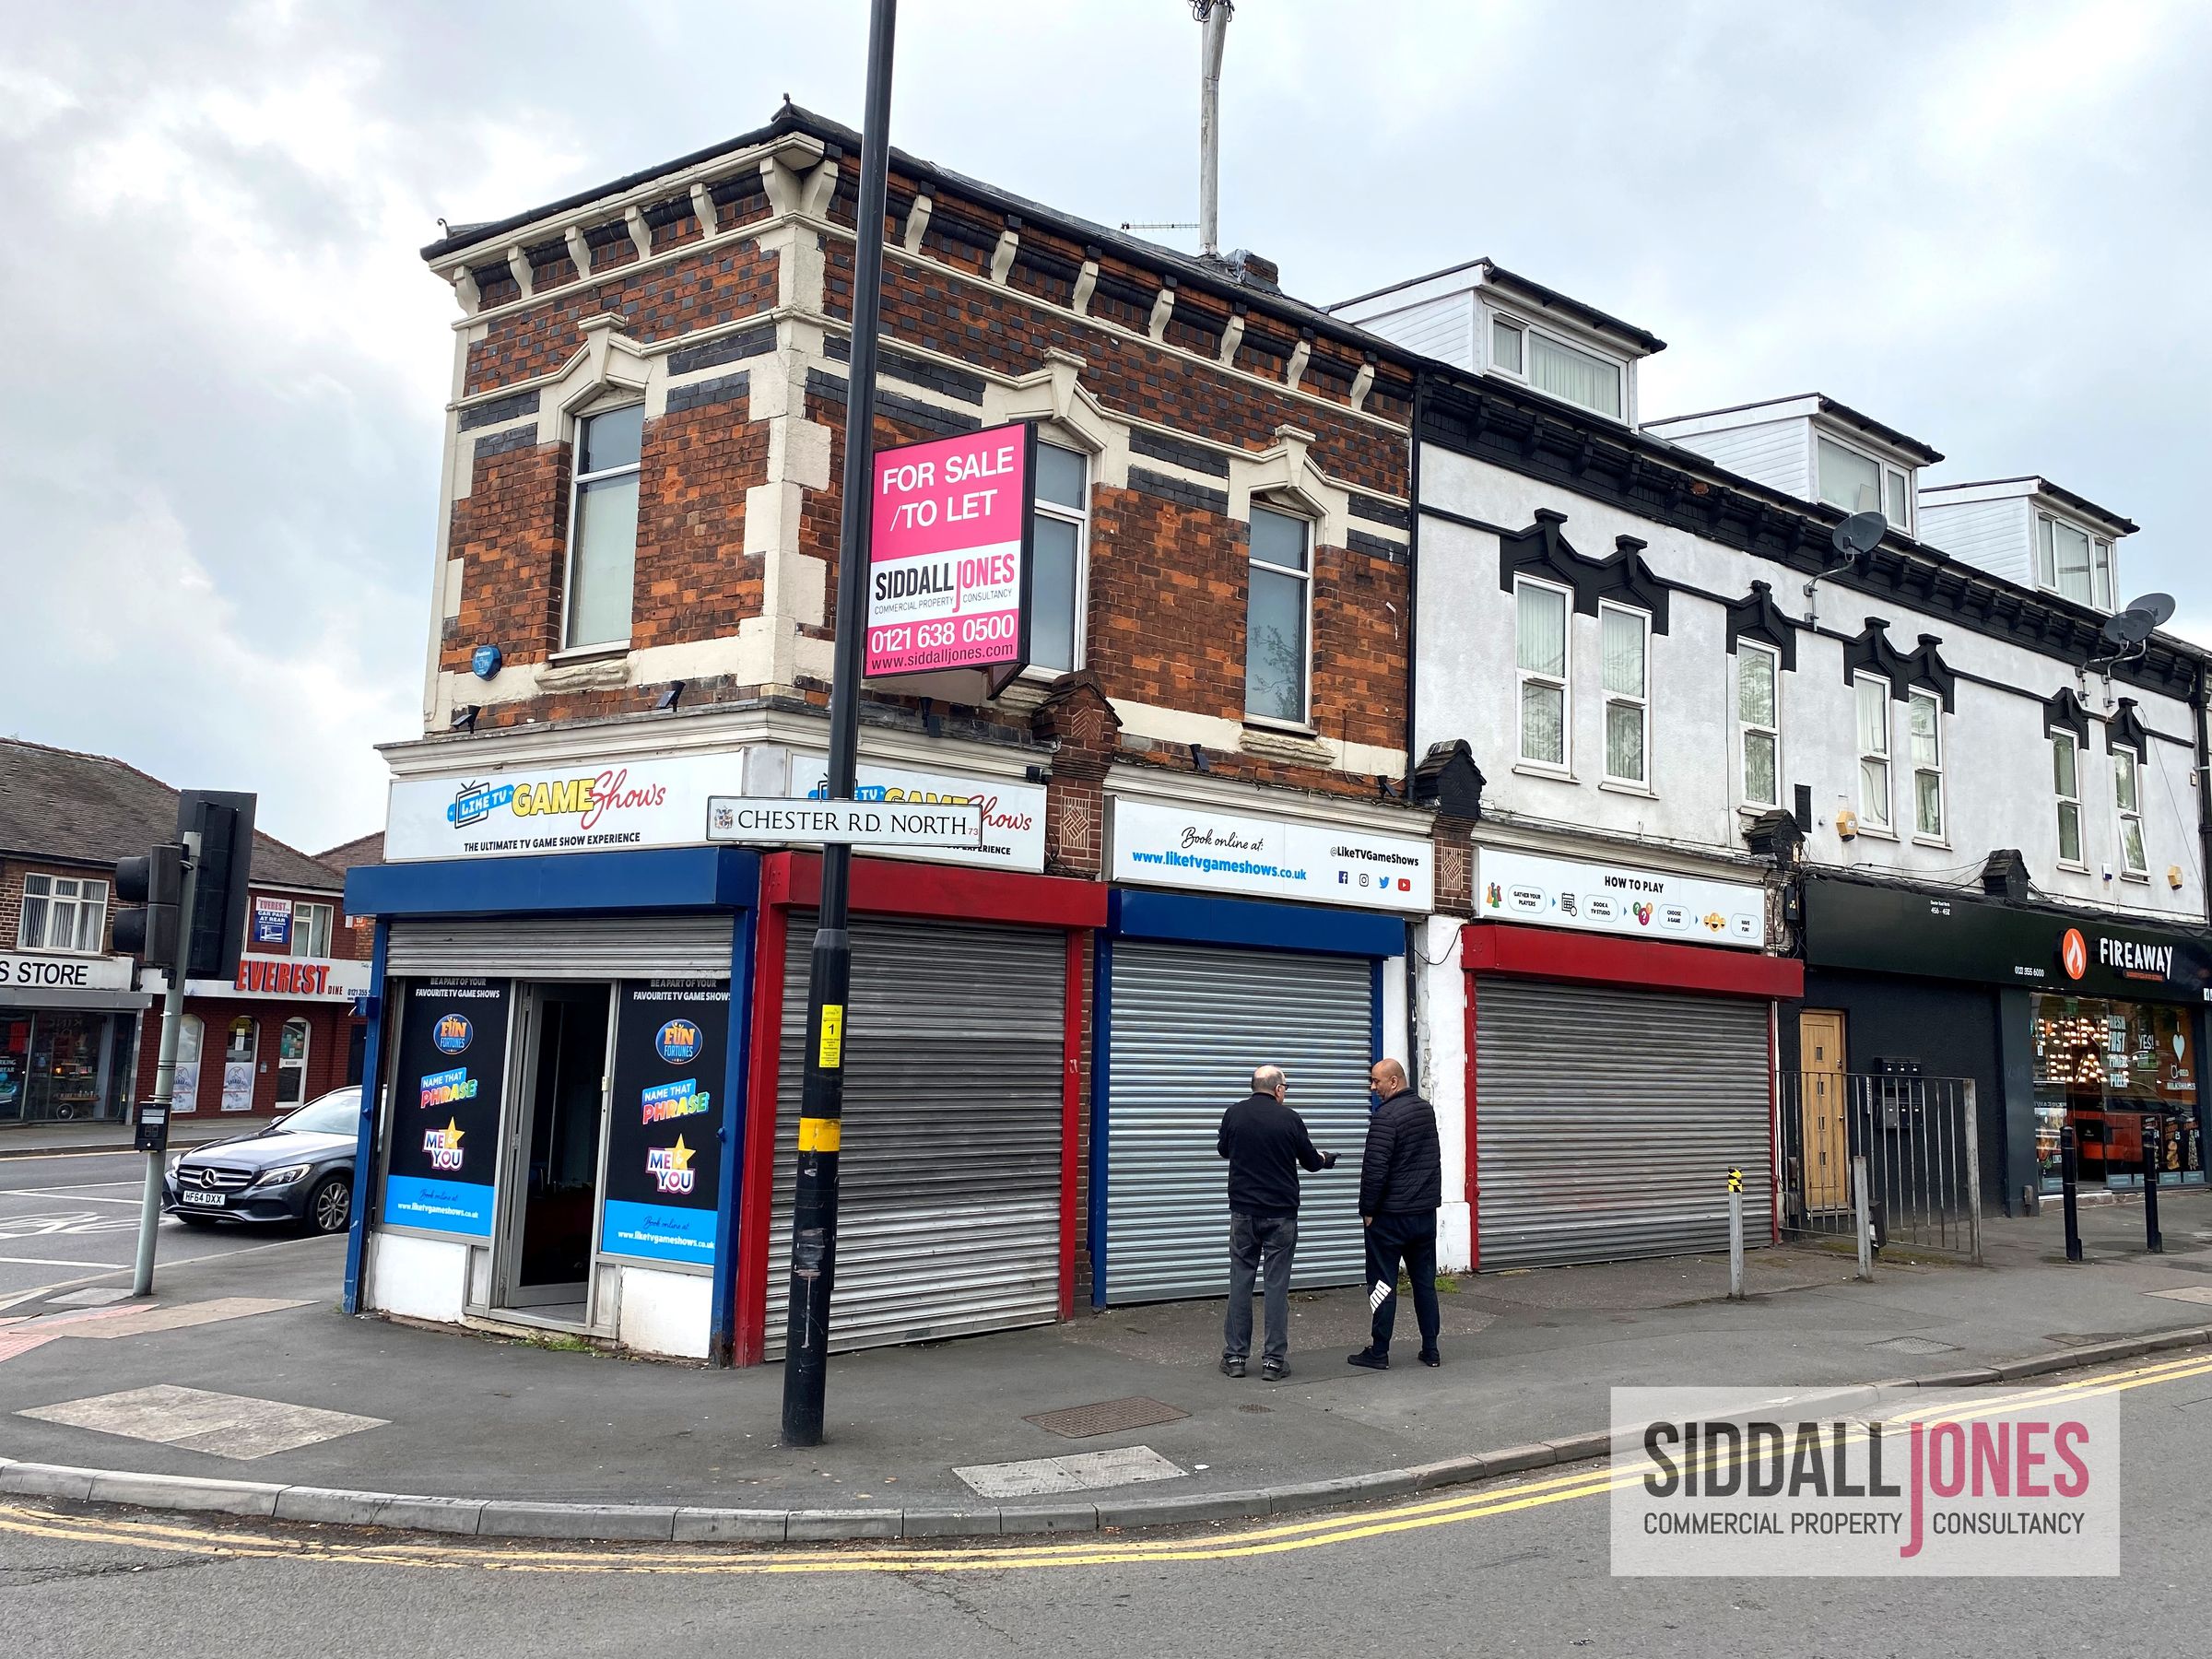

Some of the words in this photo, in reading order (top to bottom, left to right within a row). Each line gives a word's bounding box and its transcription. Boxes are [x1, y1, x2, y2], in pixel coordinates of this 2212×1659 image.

[882, 462, 935, 495] FOR
[945, 445, 1015, 483] SALE
[947, 488, 998, 523] LET
[875, 562, 954, 601] SIDDALL
[952, 553, 1015, 613] JONES
[874, 601, 918, 615] COMMERCIAL
[918, 595, 954, 610] PROPERTY
[962, 588, 1012, 604] CONSULTANCY
[871, 627, 912, 653] 0121
[917, 621, 956, 648] 638
[962, 614, 1015, 642] 0500
[871, 644, 1013, 670] www.siddalljones.com
[462, 796, 489, 814] LIKE
[492, 790, 507, 805] TV
[511, 778, 596, 817] GAME
[581, 769, 666, 830] Shows
[737, 809, 839, 831] CHESTER
[848, 813, 882, 833] RD.
[890, 815, 967, 835] NORTH
[968, 828, 979, 836] 73
[465, 842, 479, 853] THE
[480, 840, 518, 852] ULTIMATE
[520, 839, 531, 849] TV
[533, 837, 558, 848] GAME
[559, 835, 585, 846] SHOW
[587, 832, 641, 844] EXPERIENCE
[1181, 826, 1213, 849] Book
[1215, 831, 1249, 850] online
[1132, 851, 1307, 880] www.liketvgameshows.co.uk
[1330, 846, 1419, 866] @LikeTVGameShows
[1605, 876, 1627, 888] HOW
[1629, 879, 1641, 890] TO
[1643, 880, 1665, 893] PLAY
[260, 900, 287, 912] EVEREST
[2100, 936, 2173, 980] FIREAWAY
[17, 961, 89, 985] STORE
[234, 959, 331, 995] EVEREST
[430, 977, 439, 985] BE
[469, 978, 487, 986] YOUR
[416, 988, 448, 997] FAVOURITE
[449, 989, 458, 997] TV
[457, 989, 476, 998] GAME
[477, 990, 500, 998] SHOWS
[651, 979, 660, 987] BE
[661, 979, 665, 987] A
[666, 979, 684, 987] PART
[686, 979, 696, 987] OF
[697, 980, 717, 988] YOUR
[633, 991, 672, 1000] FAVOURITE
[673, 992, 683, 1000] TV
[683, 992, 705, 1001] GAME
[440, 1017, 467, 1038] FUN
[664, 1022, 696, 1045] FUN
[828, 1023, 834, 1035] 1
[440, 1037, 465, 1048] FORTUNES
[664, 1045, 693, 1058] FORTUNES
[2108, 1031, 2126, 1053] FAST
[2138, 1034, 2155, 1050] YES!
[422, 1076, 443, 1088] NAME
[445, 1072, 463, 1082] THAT
[420, 1079, 478, 1109] PHRASE
[644, 1088, 668, 1101] NAME
[670, 1083, 691, 1096] THAT
[642, 1091, 710, 1125] PHRASE
[426, 1133, 444, 1149] ME
[433, 1150, 461, 1167] YOU
[650, 1152, 671, 1170] ME
[660, 1171, 691, 1189] YOU
[206, 1194, 222, 1204] DXX
[419, 1189, 434, 1201] Book
[397, 1202, 479, 1218] www.liketvgameshows.co.uk
[642, 1216, 660, 1230] Book
[662, 1218, 680, 1230] online
[618, 1230, 715, 1249] www.liketvgameshows.co.uk
